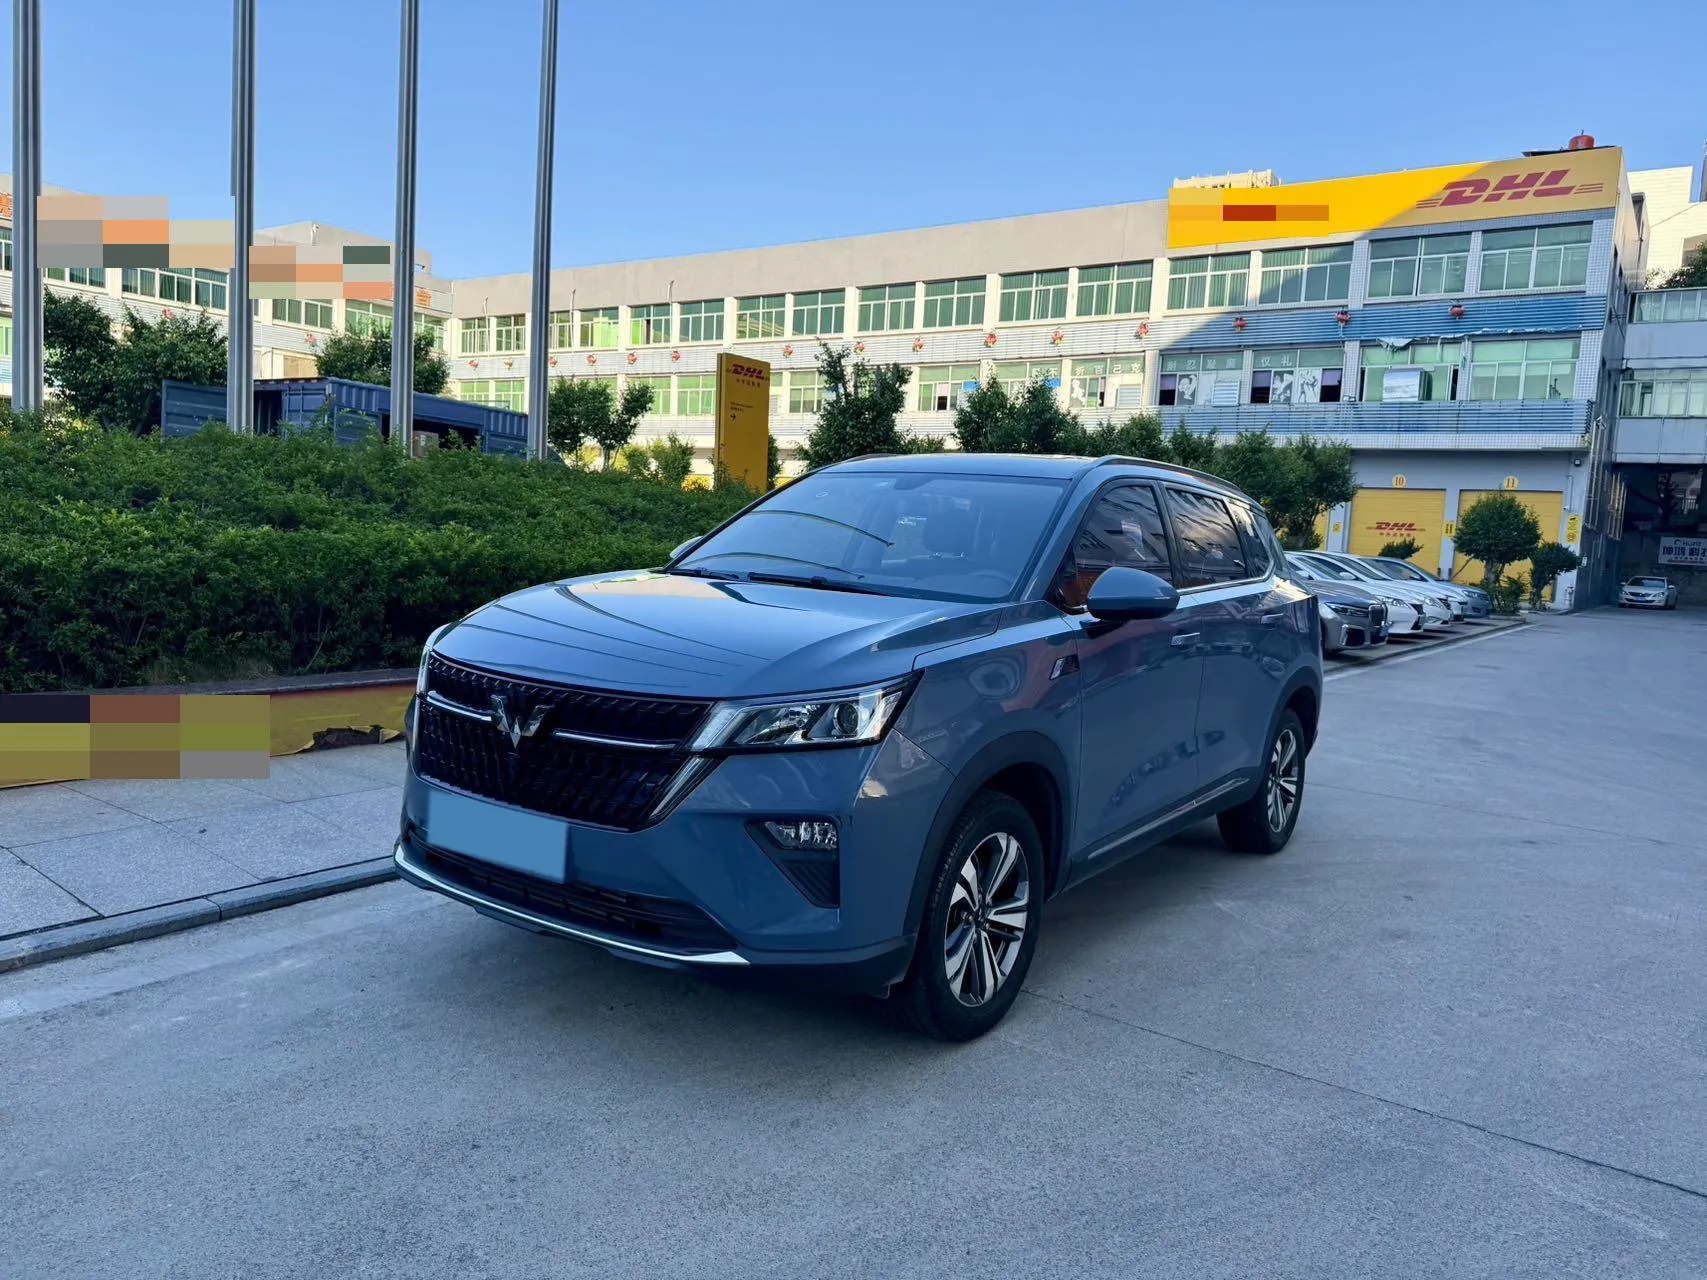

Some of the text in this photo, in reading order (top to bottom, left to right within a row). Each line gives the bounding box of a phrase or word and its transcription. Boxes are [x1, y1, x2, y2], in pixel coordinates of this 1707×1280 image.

[1439, 168, 1576, 207] DHL
[732, 363, 764, 380] DHL
[1395, 476, 1404, 486] 10
[1506, 478, 1515, 488] 11
[1375, 521, 1417, 531] DHL
